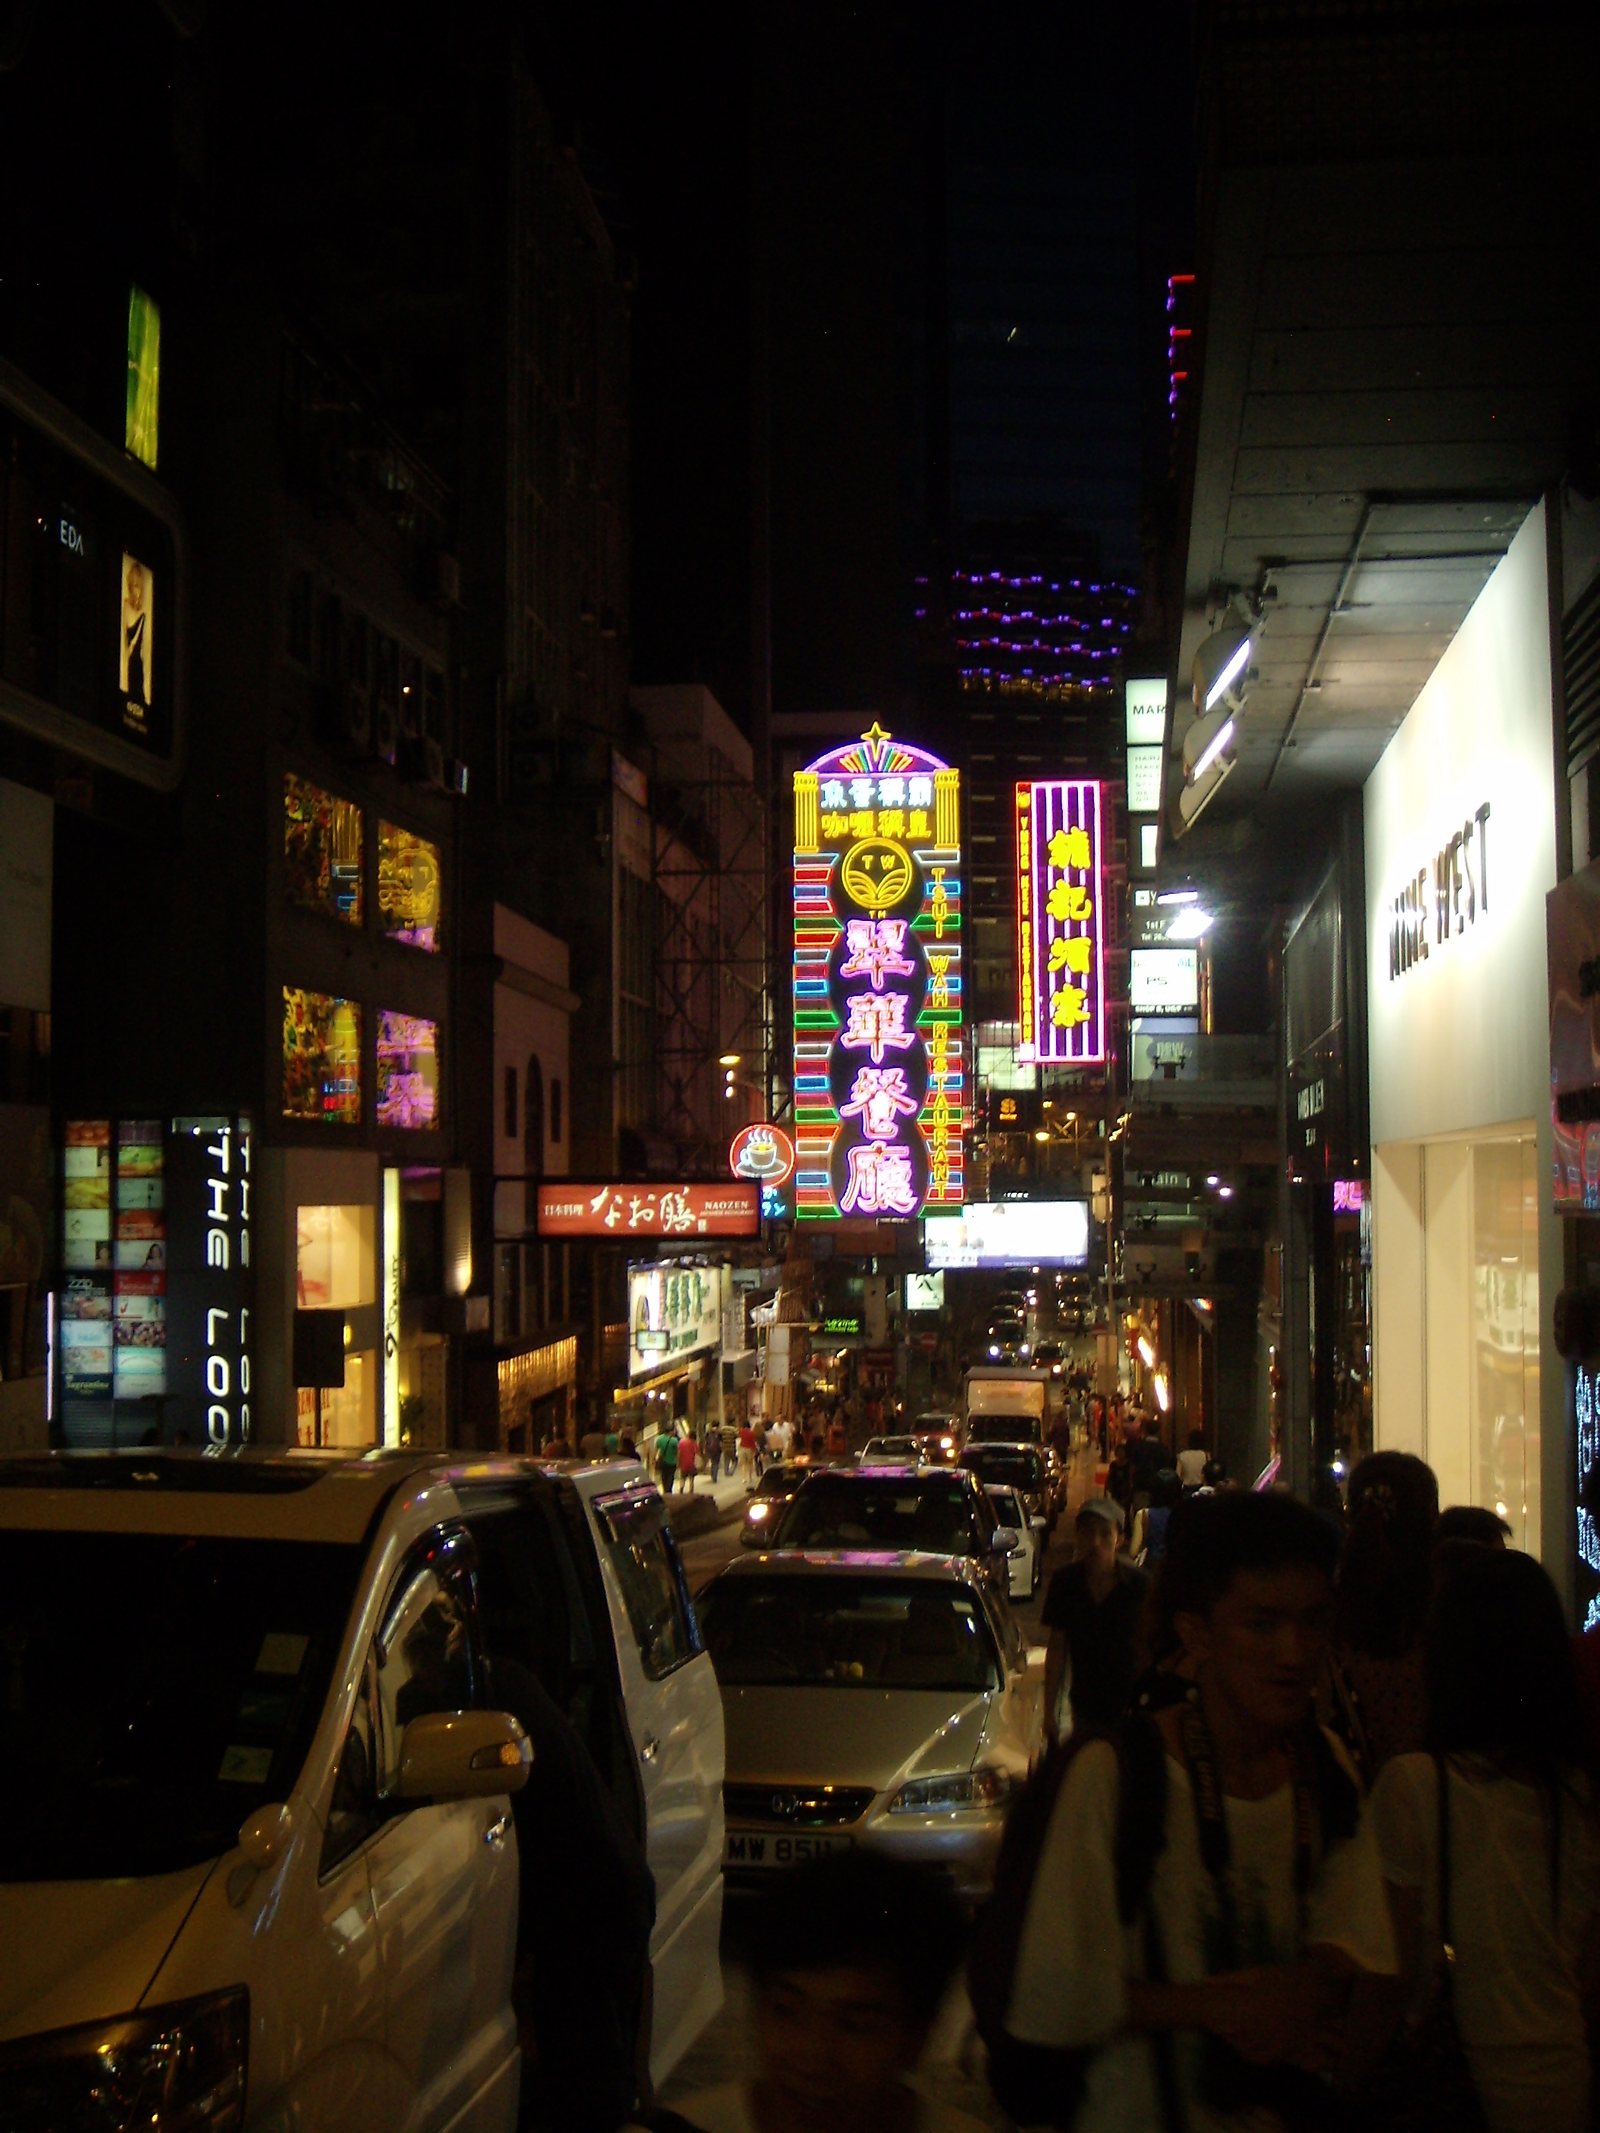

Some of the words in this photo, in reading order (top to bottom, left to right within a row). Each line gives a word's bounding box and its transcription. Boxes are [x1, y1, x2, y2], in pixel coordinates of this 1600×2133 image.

[931, 867, 948, 938] TSUI
[1389, 867, 1429, 982] NINE
[1432, 801, 1491, 945] WEST
[929, 955, 949, 1008] WAH
[840, 919, 918, 1214] 翠華餐廳
[932, 1021, 949, 1200] RESTAURANT
[207, 1134, 230, 1271] THE
[704, 1200, 749, 1210] NAOZEN
